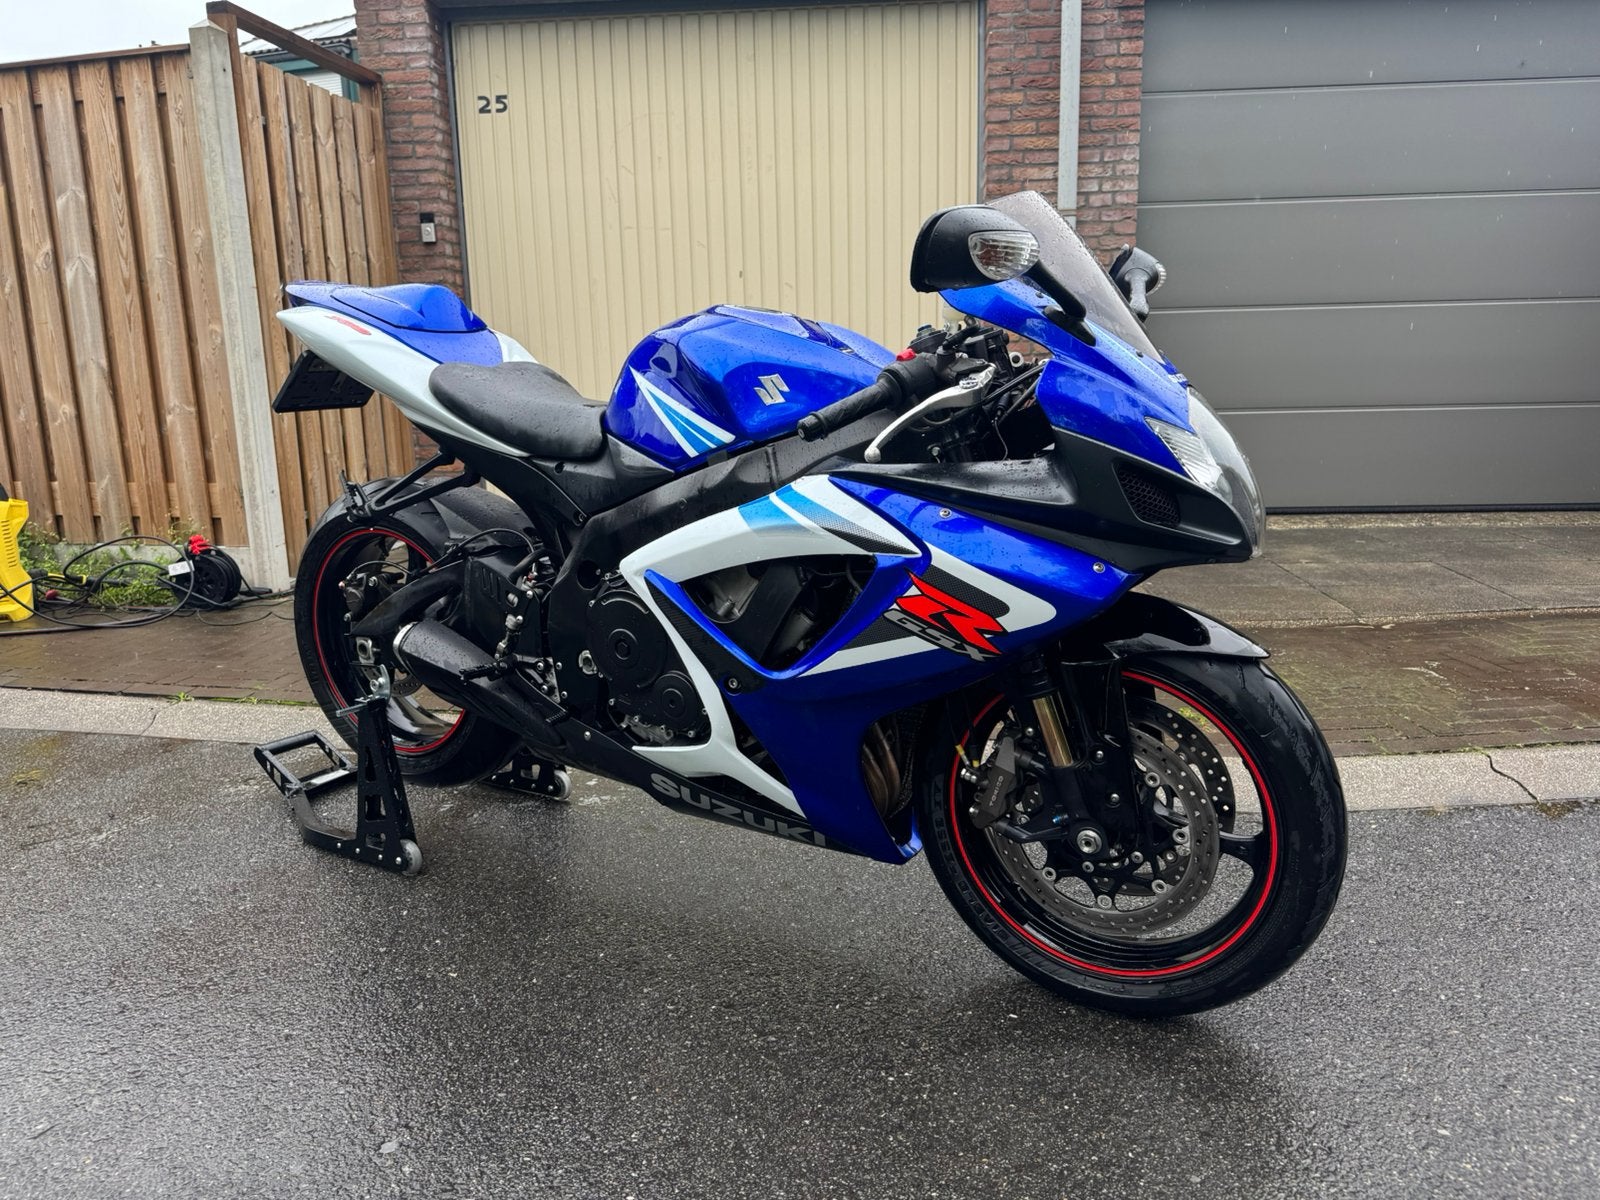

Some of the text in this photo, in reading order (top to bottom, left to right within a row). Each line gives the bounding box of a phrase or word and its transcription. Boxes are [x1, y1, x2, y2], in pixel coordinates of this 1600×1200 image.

[477, 95, 508, 114] 25
[989, 775, 1004, 807] TOKICO
[650, 773, 826, 847] SUZUKI
